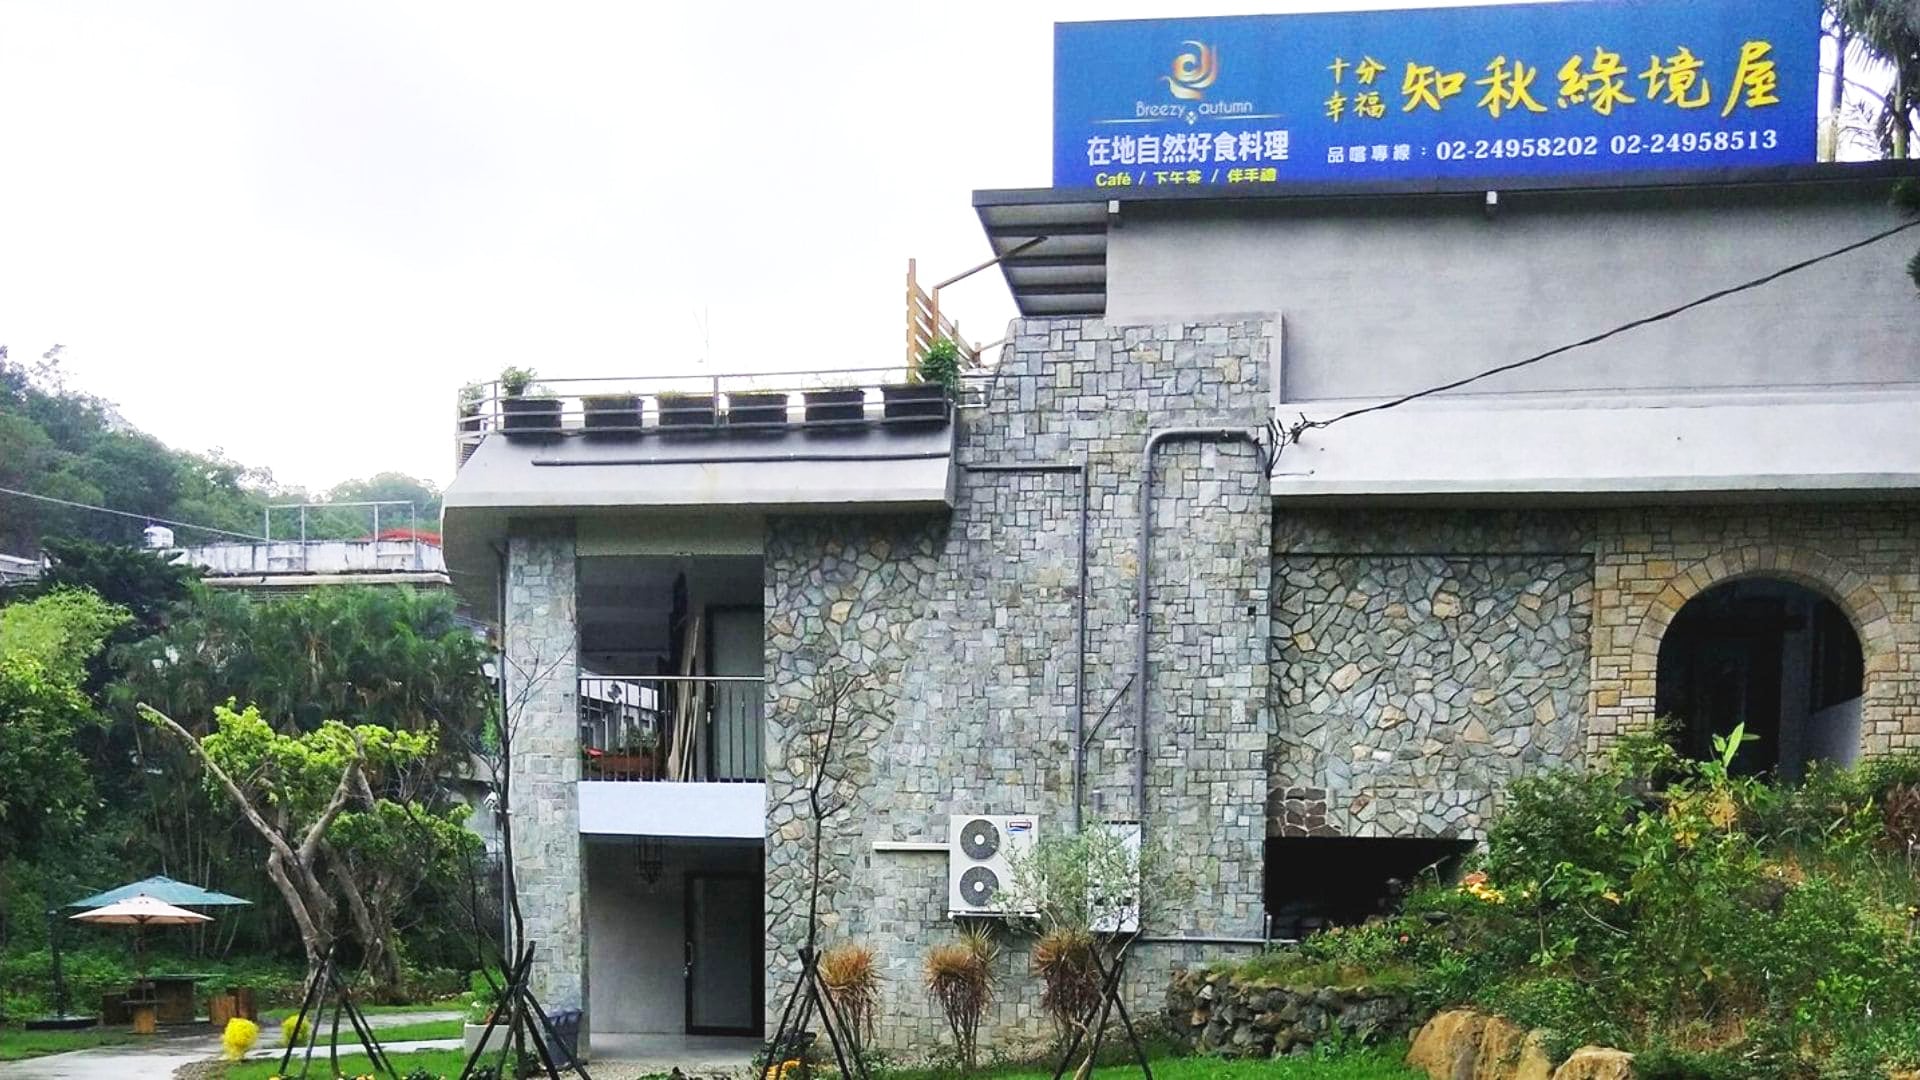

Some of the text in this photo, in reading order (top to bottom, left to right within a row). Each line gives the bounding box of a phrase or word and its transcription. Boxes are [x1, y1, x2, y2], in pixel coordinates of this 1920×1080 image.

[1326, 55, 1386, 84] 十分
[1136, 101, 1252, 118] Breezy autumn
[1323, 90, 1386, 122] 幸福
[1087, 130, 1289, 166] 在地自然好食料理
[1436, 135, 1598, 160] 02-24958202
[1610, 129, 1777, 154] 02-24958513
[1095, 172, 1132, 187] Café
[1153, 170, 1202, 184] 下午茶
